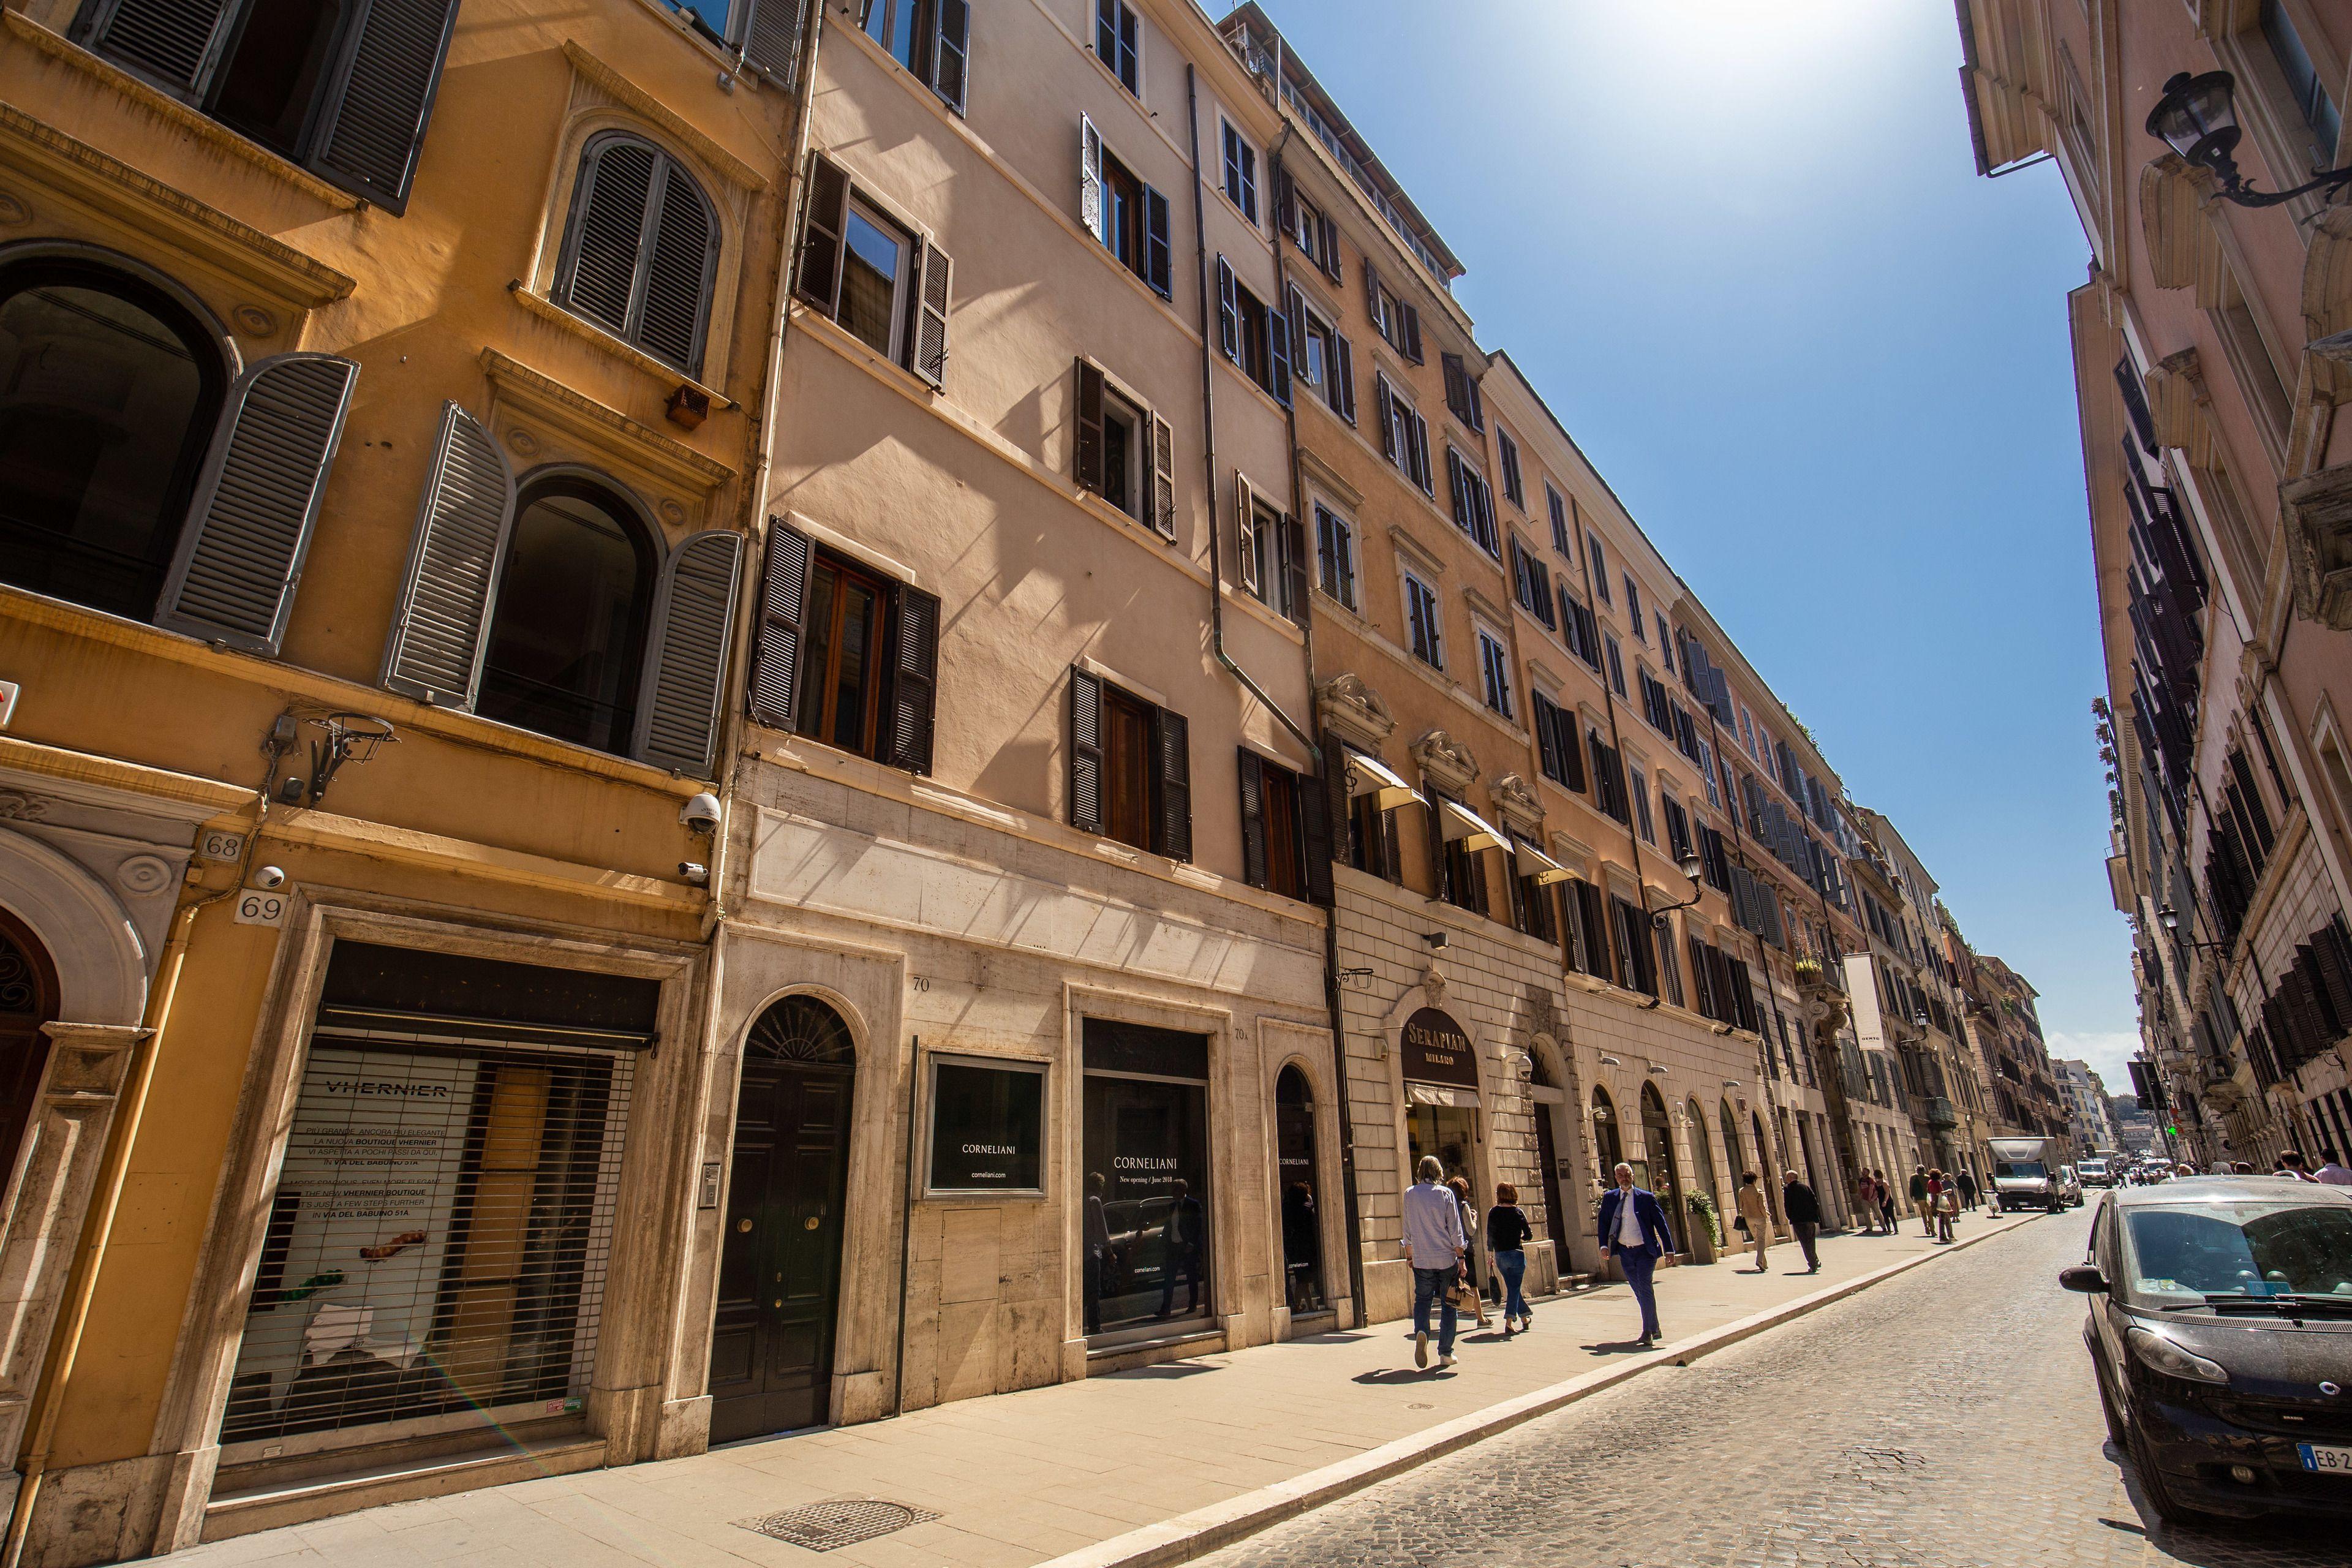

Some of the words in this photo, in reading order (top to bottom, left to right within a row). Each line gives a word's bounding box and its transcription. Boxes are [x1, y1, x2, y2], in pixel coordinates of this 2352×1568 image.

[207, 836, 238, 856] 68
[241, 896, 281, 920] 69
[913, 977, 929, 992] 70
[1409, 1022, 1466, 1052] SERAPIAN
[326, 1081, 447, 1097] VHERNIER
[962, 1144, 1015, 1155] CORNELIANI
[1114, 1156, 1177, 1169] CORNELIANI
